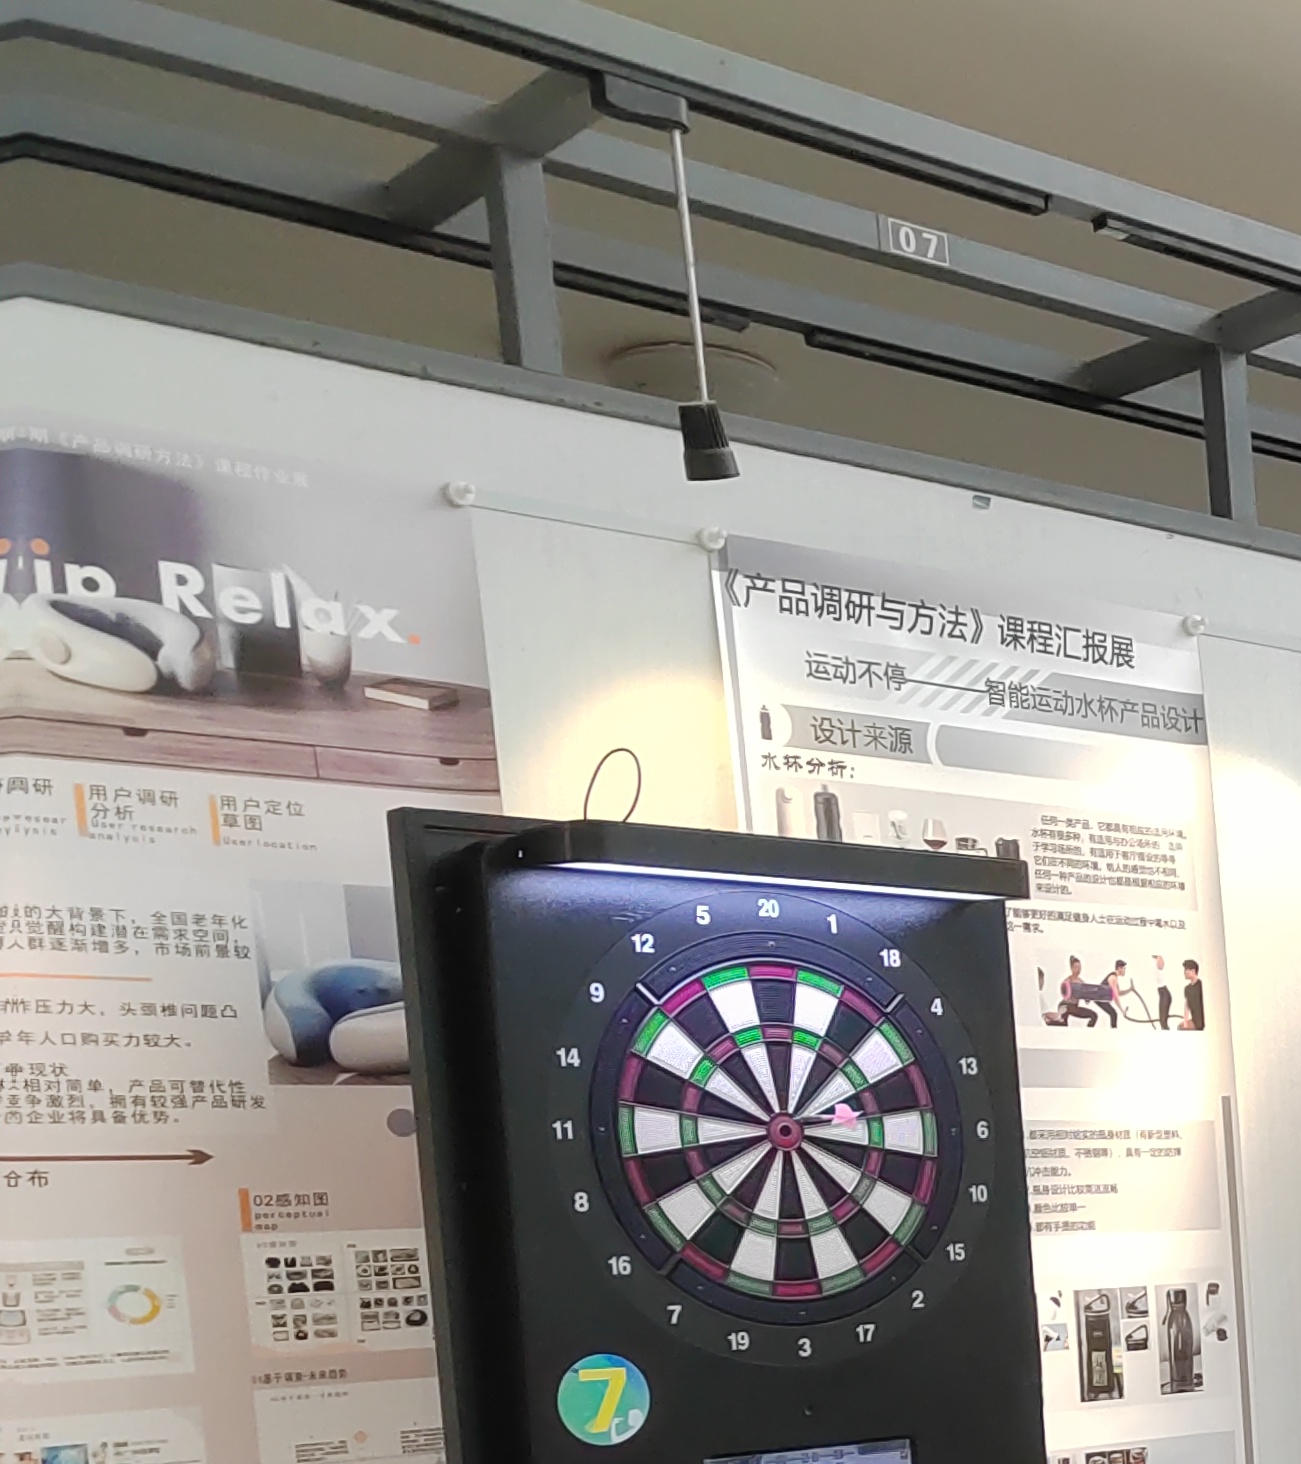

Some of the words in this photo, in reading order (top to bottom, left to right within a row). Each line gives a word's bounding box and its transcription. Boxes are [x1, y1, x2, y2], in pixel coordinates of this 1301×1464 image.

[899, 226, 938, 258] 07
[809, 716, 915, 755] 设计来源
[88, 784, 180, 808] 用户调研
[91, 804, 135, 821] 分析
[220, 795, 306, 818] 用户定位
[221, 813, 263, 832] 草图
[696, 905, 710, 925] 5
[757, 898, 780, 918] 20
[827, 915, 838, 933] 1
[632, 933, 655, 954] 12
[879, 948, 901, 967] 18
[589, 983, 605, 1003] 9
[930, 998, 943, 1016] 4
[556, 1048, 581, 1068] 14
[959, 1056, 978, 1075] 13
[552, 1120, 574, 1140] 11
[976, 1120, 989, 1140] 6
[253, 1191, 330, 1208] 02感知图
[573, 1192, 589, 1212] 8
[968, 1184, 988, 1203] 10
[947, 1243, 966, 1262] 15
[608, 1255, 632, 1276] 16
[912, 1290, 926, 1309] 2
[667, 1305, 682, 1325] 7
[728, 1331, 750, 1351] 19
[856, 1323, 876, 1343] 17
[798, 1336, 812, 1357] 3
[578, 1367, 627, 1433] 7
